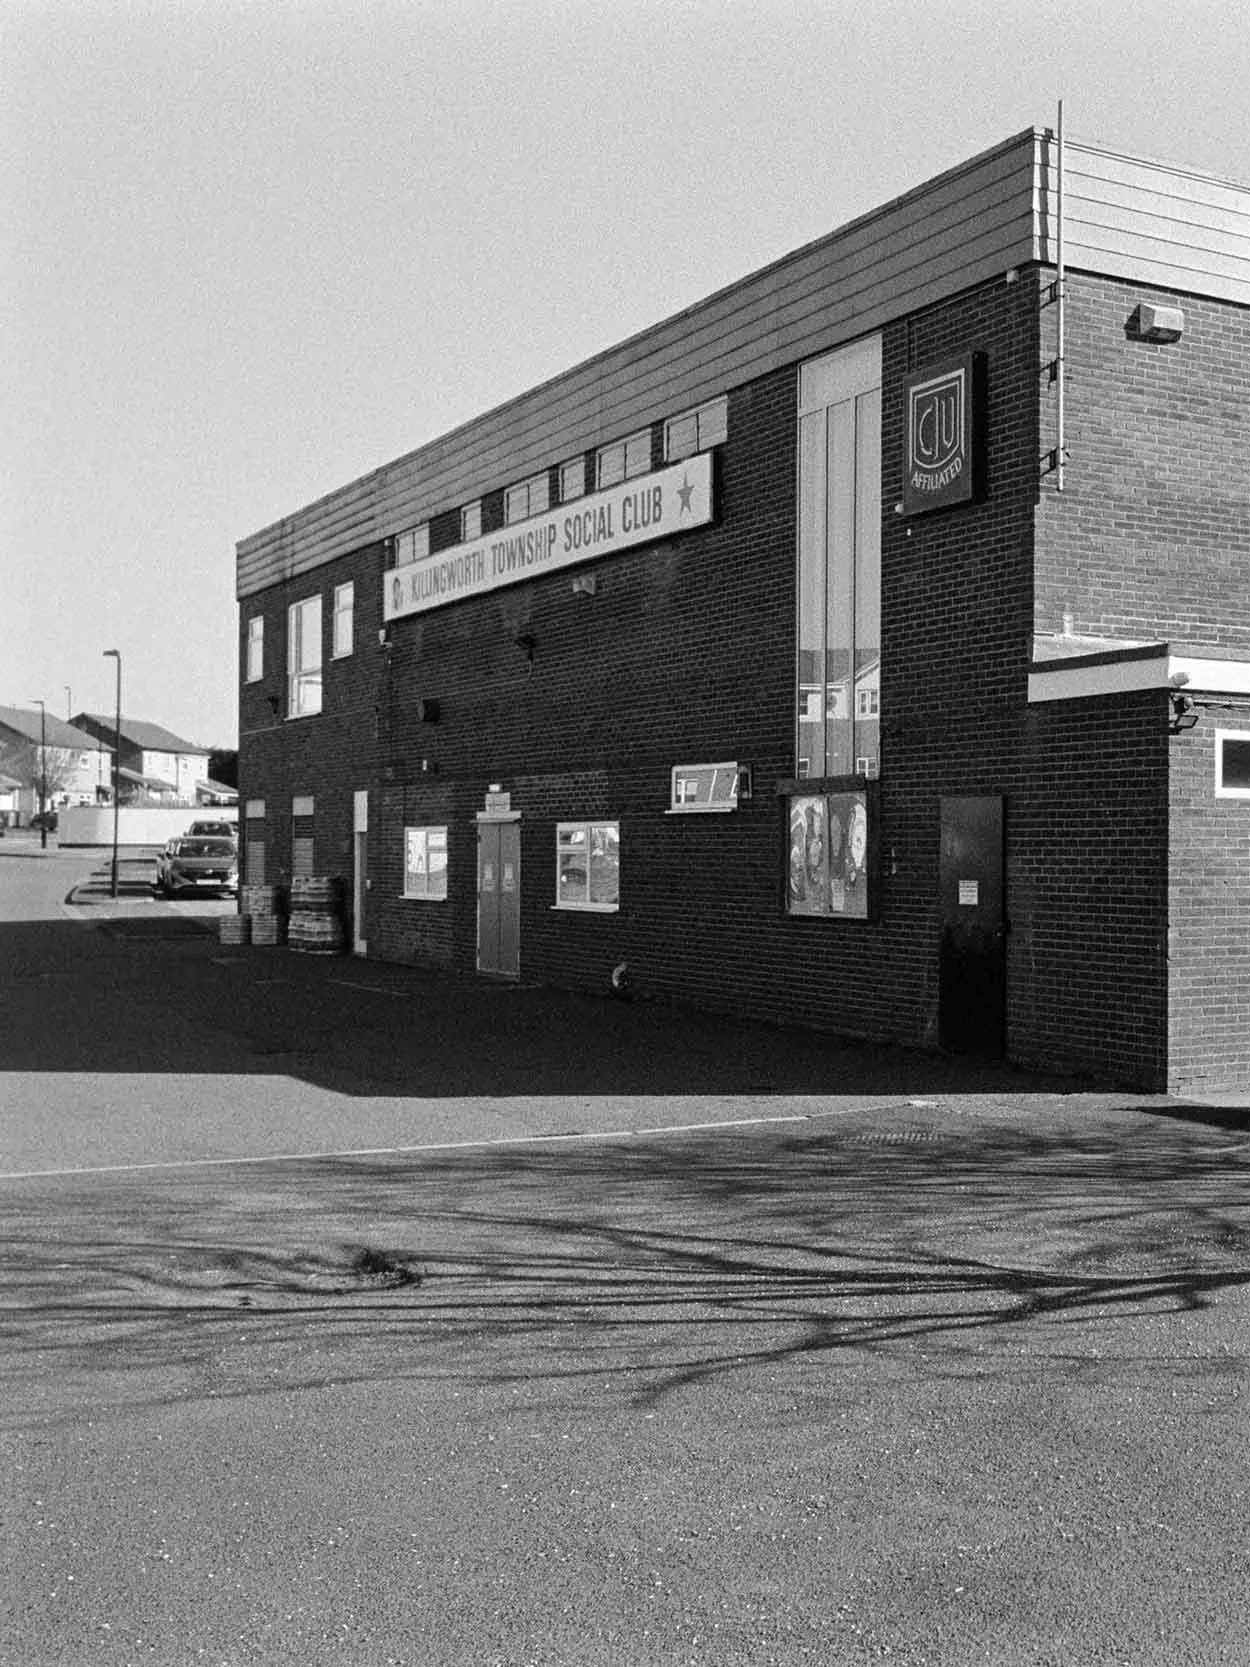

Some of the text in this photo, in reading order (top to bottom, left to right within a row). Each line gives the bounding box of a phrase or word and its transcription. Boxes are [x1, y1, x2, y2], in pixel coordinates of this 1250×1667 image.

[911, 457, 962, 490] AFFILIATED
[412, 485, 662, 600] KILLINGWORTH TOWNSHIP SOCIAL CLUB
